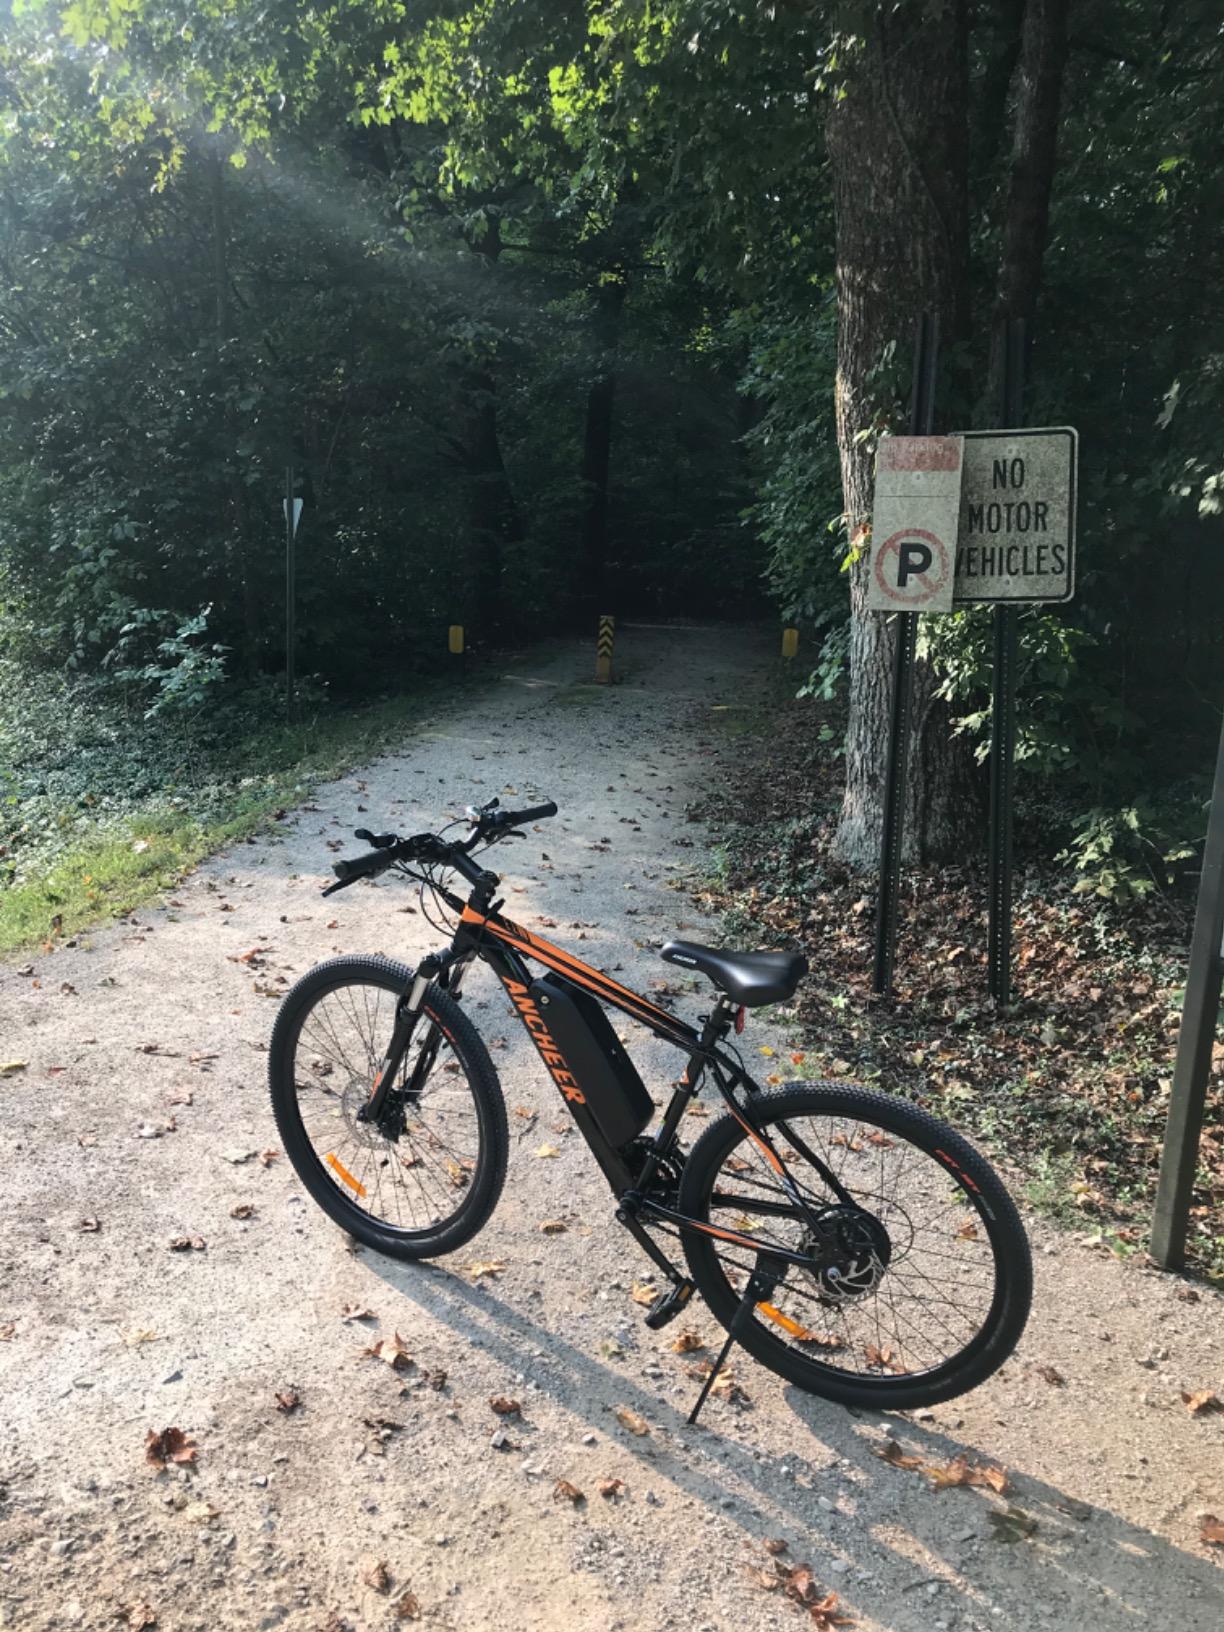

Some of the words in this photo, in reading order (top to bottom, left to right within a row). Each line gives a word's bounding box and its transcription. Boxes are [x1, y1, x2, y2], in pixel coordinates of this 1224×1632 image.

[992, 457, 1025, 490] NO
[967, 501, 1048, 534] MOTOR
[897, 542, 932, 587] P
[502, 975, 586, 1105] ANCHEER
